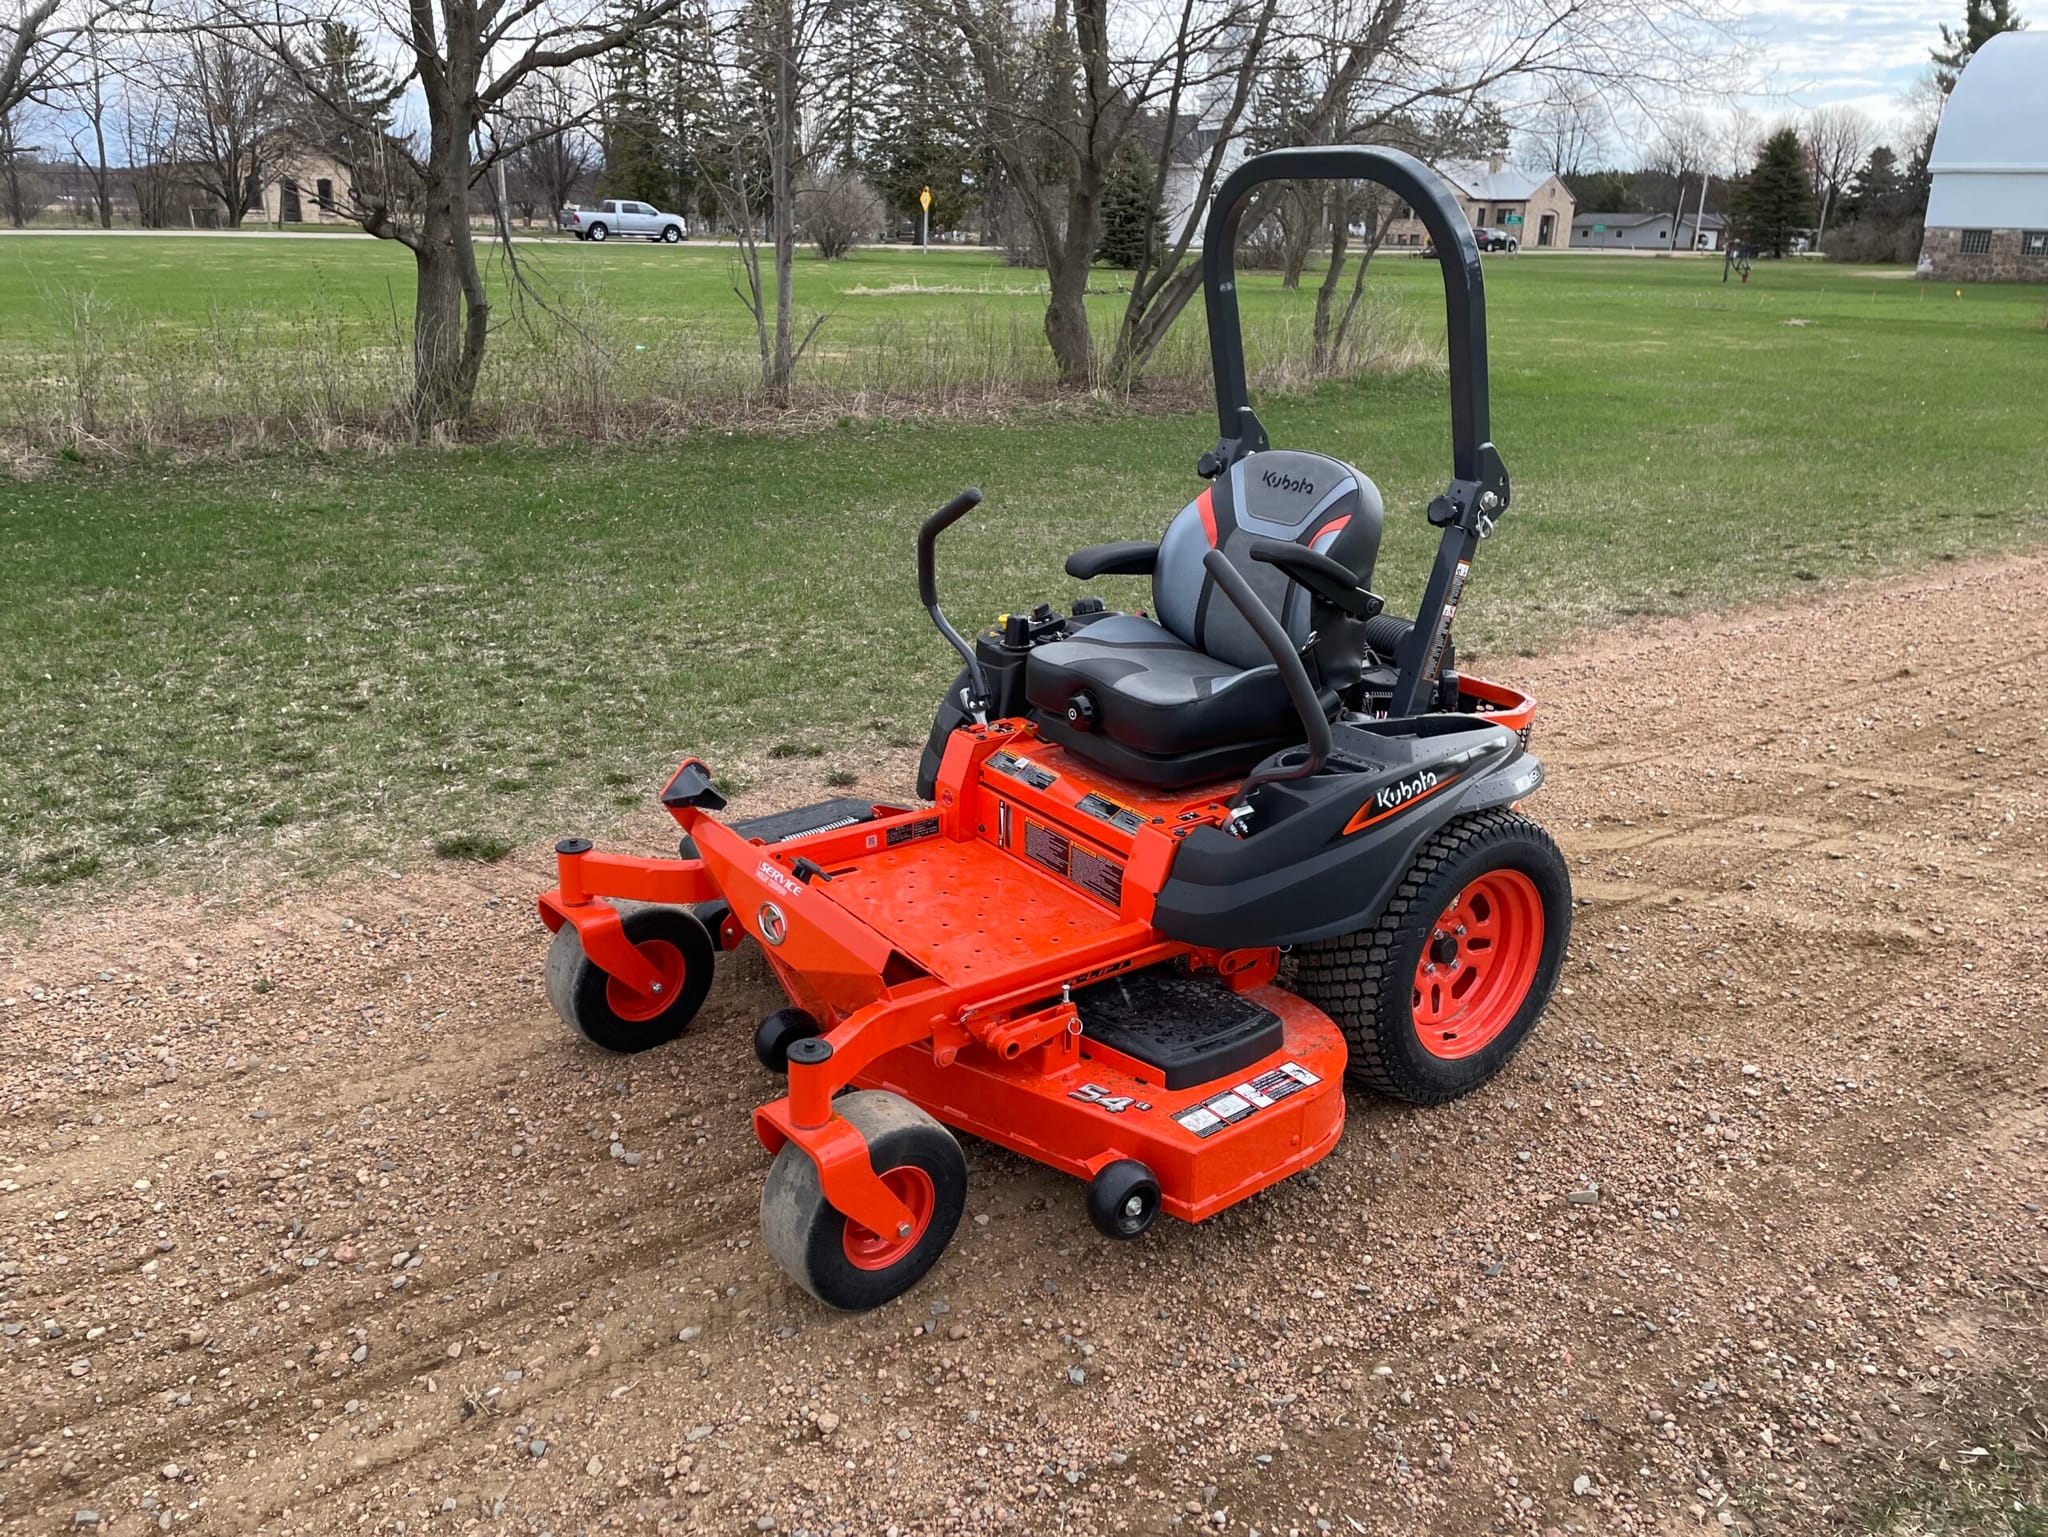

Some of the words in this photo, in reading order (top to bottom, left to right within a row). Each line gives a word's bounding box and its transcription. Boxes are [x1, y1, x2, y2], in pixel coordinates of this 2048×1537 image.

[1263, 470, 1314, 495] Kubota
[1376, 770, 1438, 809] Kubota
[759, 861, 804, 897] SERVICE
